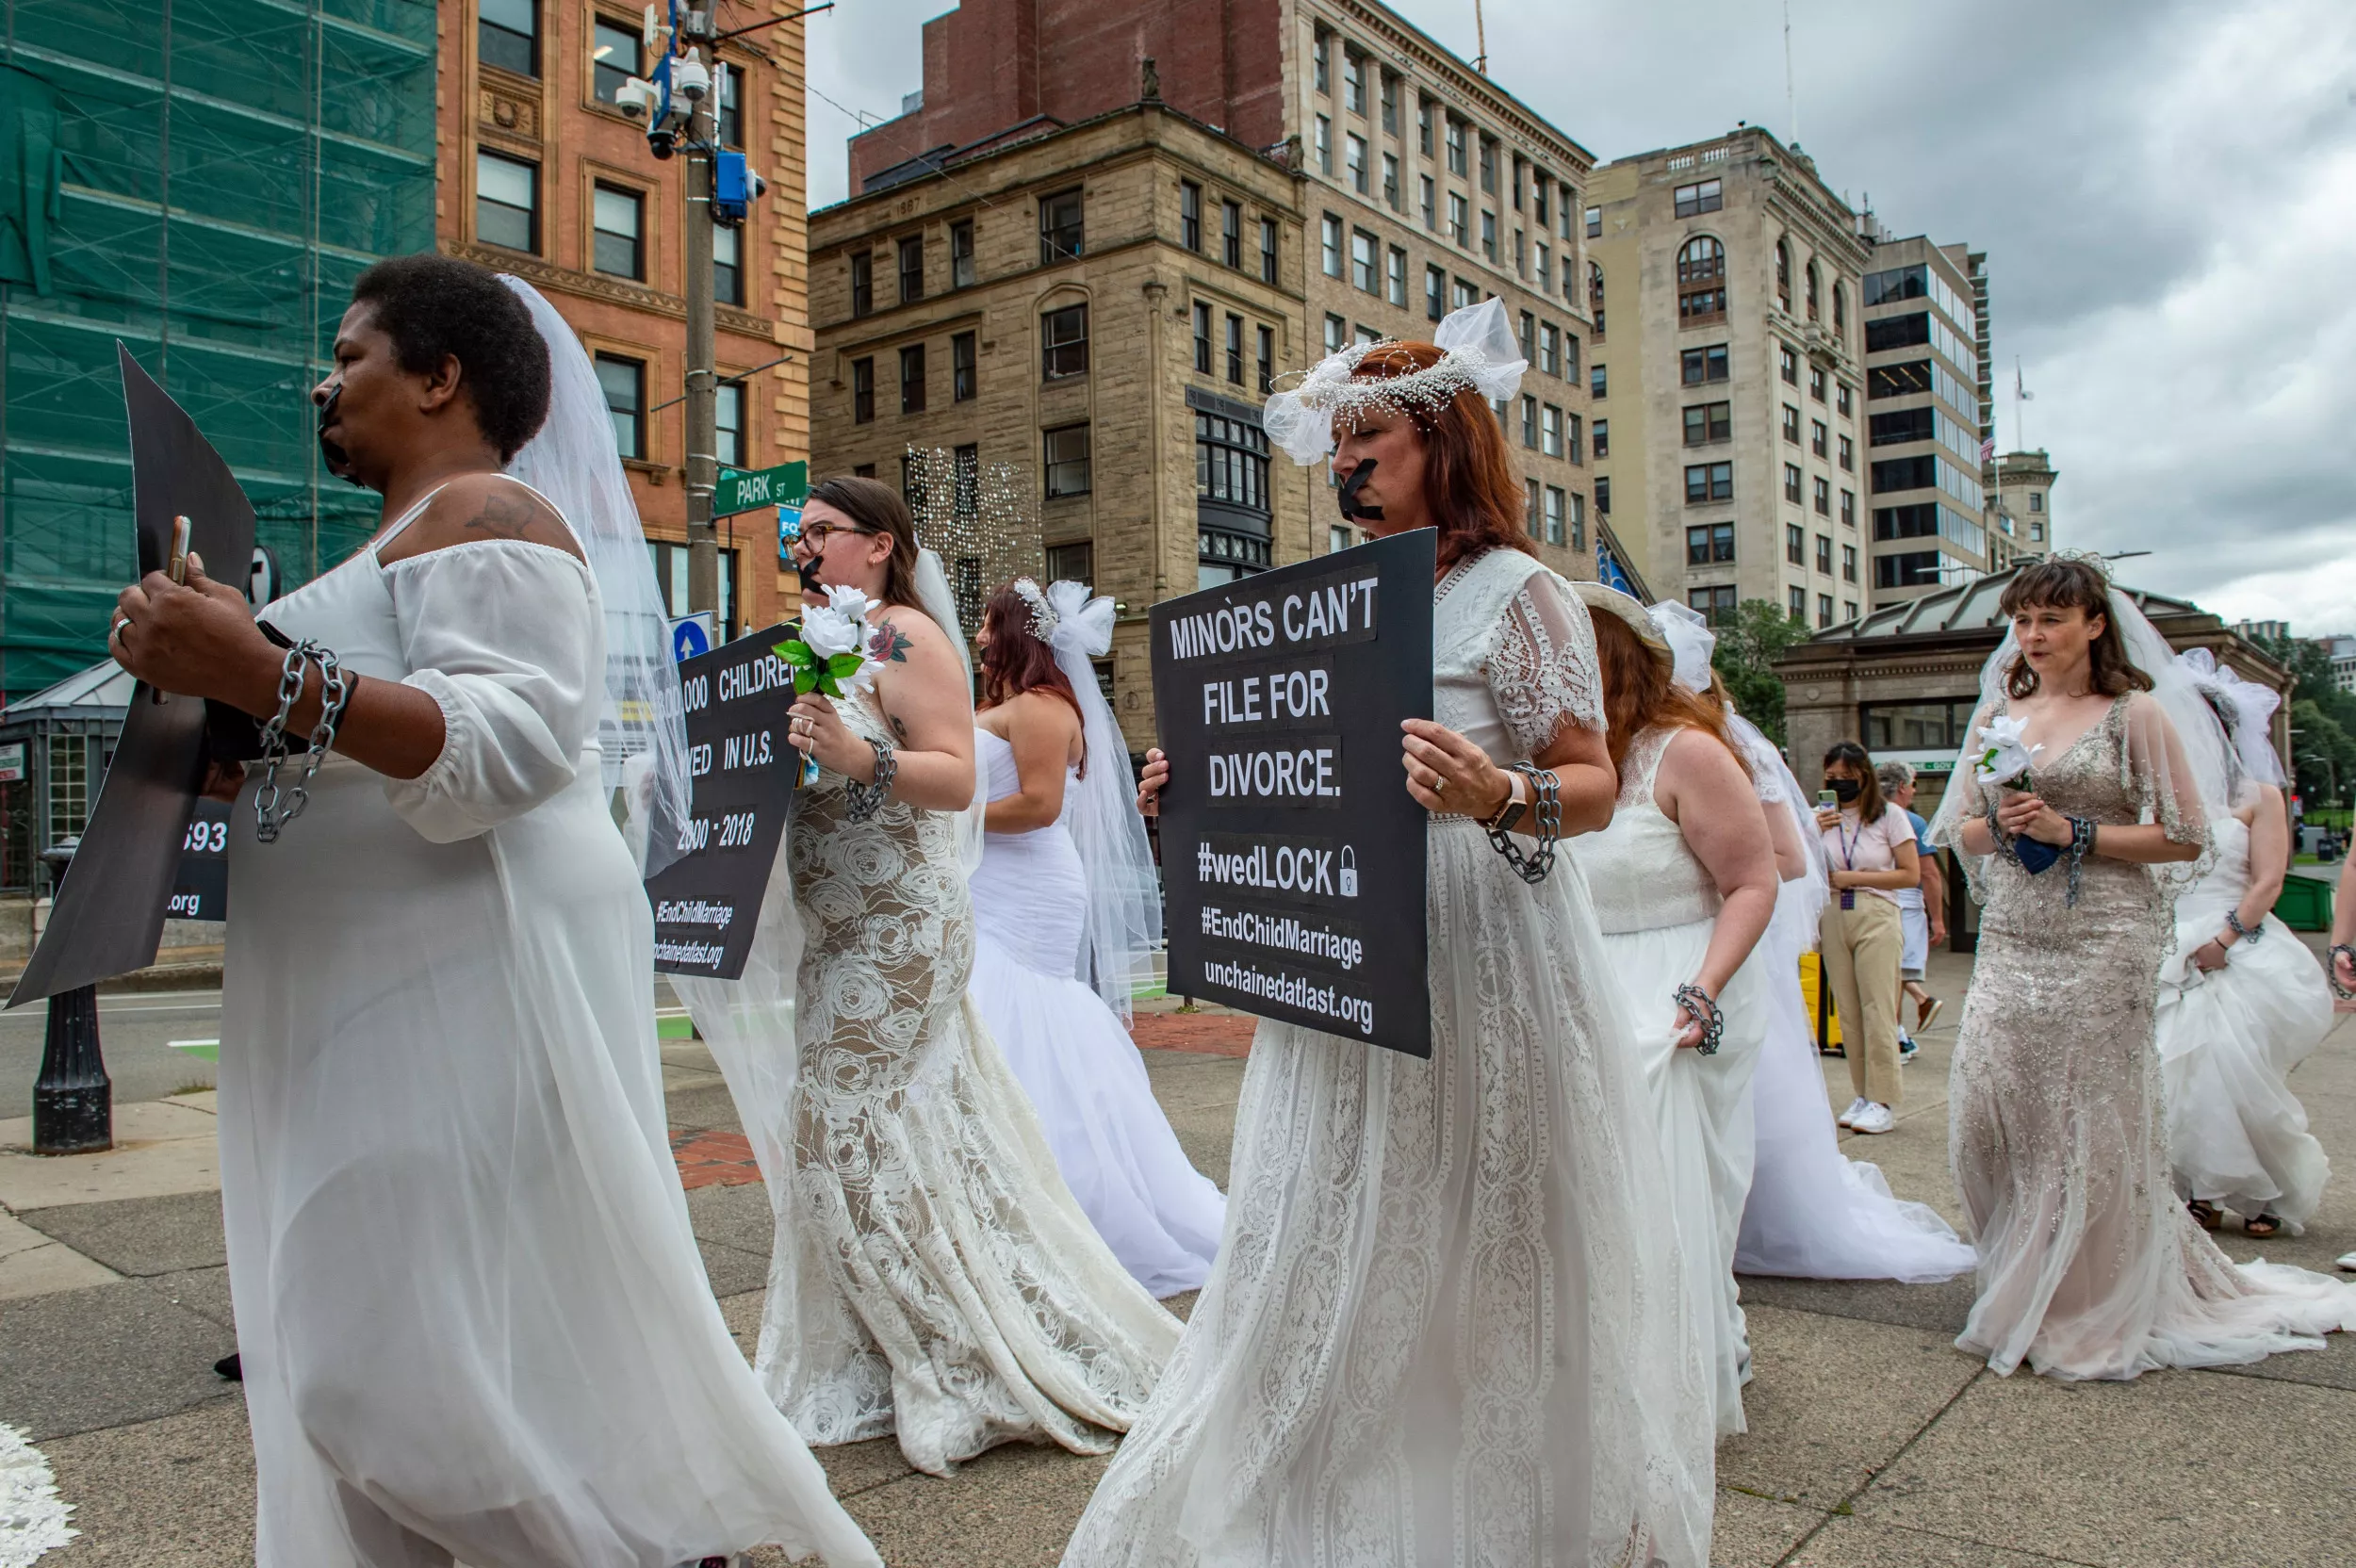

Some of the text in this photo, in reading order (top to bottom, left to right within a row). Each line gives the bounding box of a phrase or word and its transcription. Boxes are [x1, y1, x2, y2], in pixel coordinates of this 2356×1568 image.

[737, 474, 786, 505] PARK ST
[1283, 577, 1378, 642] CAN'T
[1203, 669, 1330, 725] FILE FOR
[724, 736, 741, 770] IN
[744, 730, 774, 767] U.S.
[1209, 748, 1341, 797] DIVORCE.
[719, 812, 755, 847] 2018
[1198, 842, 1333, 896] #wedLOCK
[656, 901, 733, 930] #EndChildMarriage
[1202, 906, 1363, 970] #EndChildMarriage
[653, 939, 725, 970] nchainedatlast.org
[1204, 959, 1373, 1035] unchainedatlast.org
